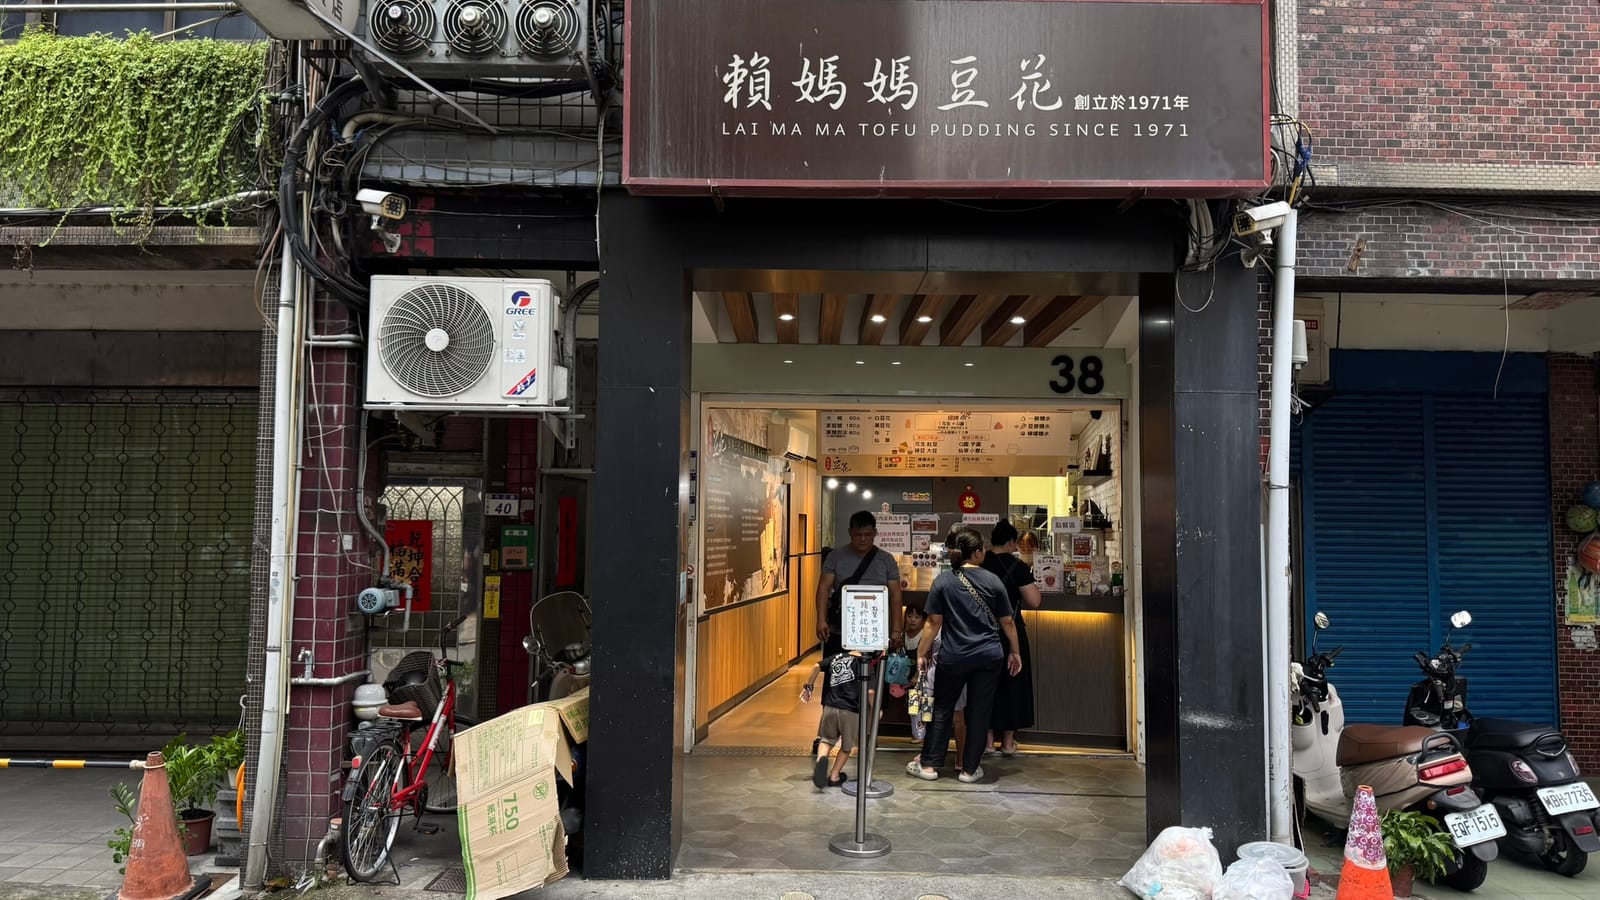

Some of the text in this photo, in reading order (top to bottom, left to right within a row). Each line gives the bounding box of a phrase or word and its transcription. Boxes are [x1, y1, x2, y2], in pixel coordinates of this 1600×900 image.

[722, 51, 1063, 111] 賴媽媽豆花
[1074, 94, 1190, 111] 創立於1971年
[722, 122, 1189, 137] LAI MA MA TOFU PUDDING SINCE 1971
[505, 307, 537, 316] GREE
[1049, 354, 1104, 394] 38
[494, 502, 512, 515] 40
[502, 792, 520, 831] 750
